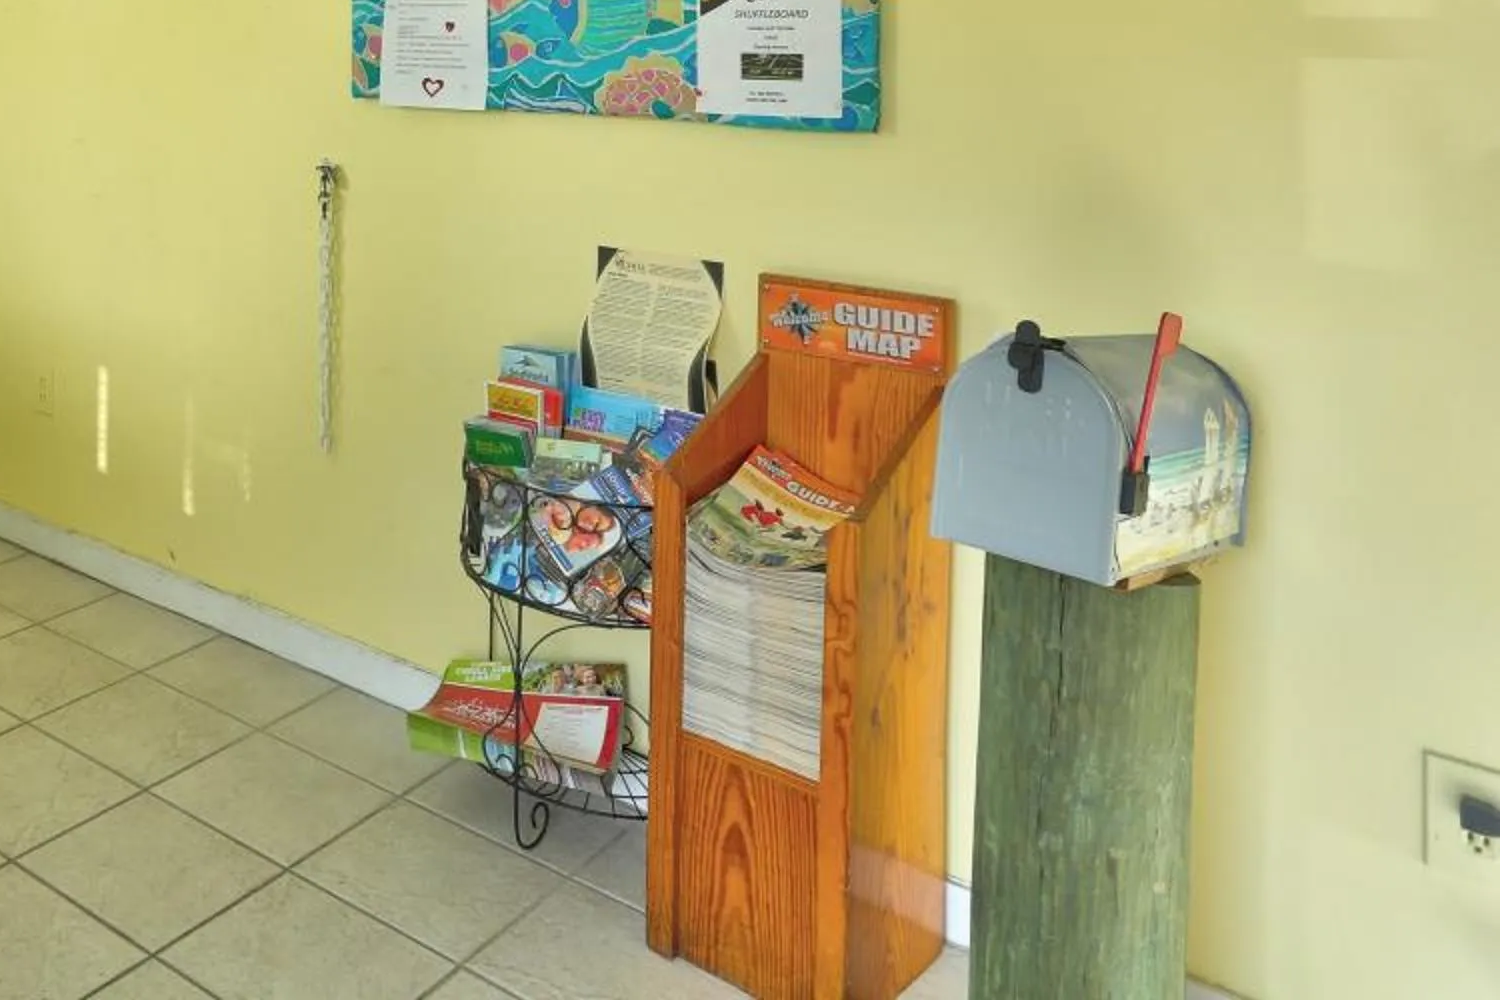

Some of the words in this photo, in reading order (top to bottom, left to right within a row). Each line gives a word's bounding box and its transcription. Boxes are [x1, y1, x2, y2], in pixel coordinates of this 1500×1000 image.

[734, 8, 809, 19] SHUFFLEBOARD
[834, 302, 934, 337] GUIDE
[847, 328, 922, 359] MAP
